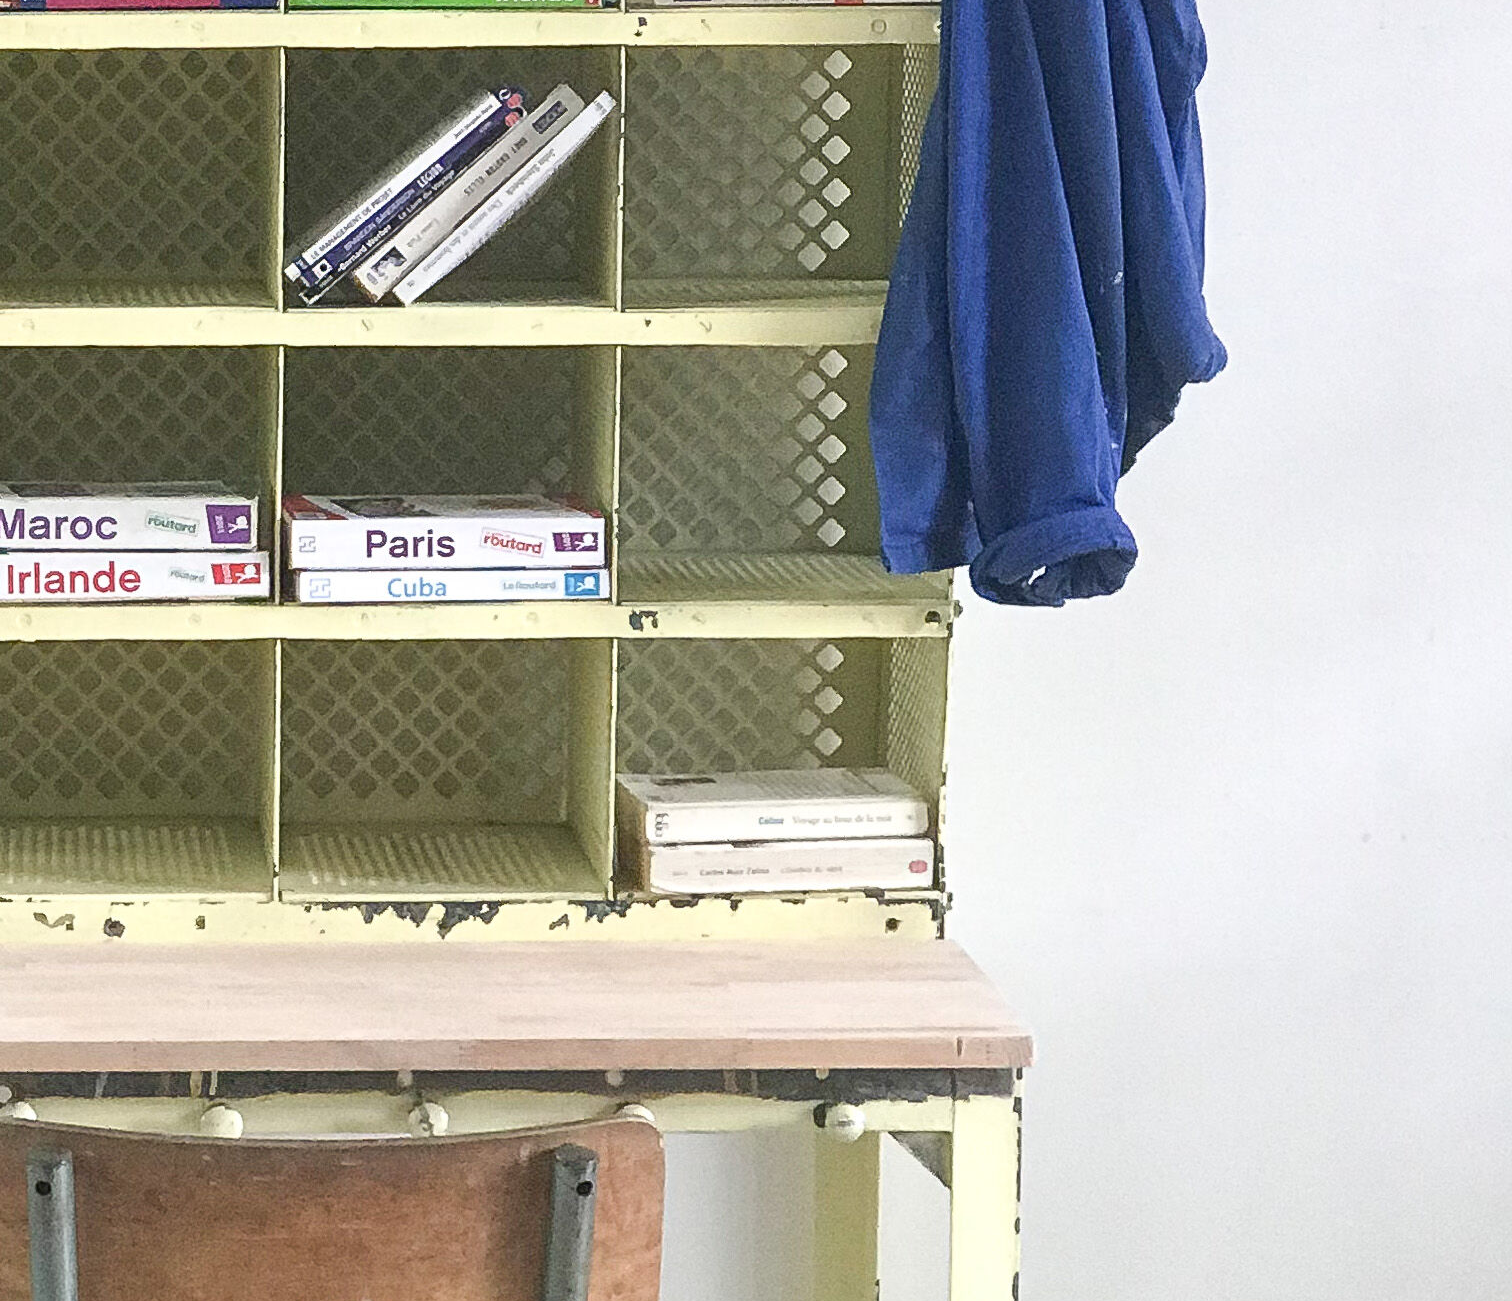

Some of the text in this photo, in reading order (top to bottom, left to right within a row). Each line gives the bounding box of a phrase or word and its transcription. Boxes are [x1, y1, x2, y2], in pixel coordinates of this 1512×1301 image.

[361, 206, 372, 217] DE
[148, 515, 197, 534] routard
[366, 529, 456, 559] Paris
[483, 533, 543, 555] routard
[7, 561, 141, 594] Irlande
[387, 577, 447, 598] Cuba
